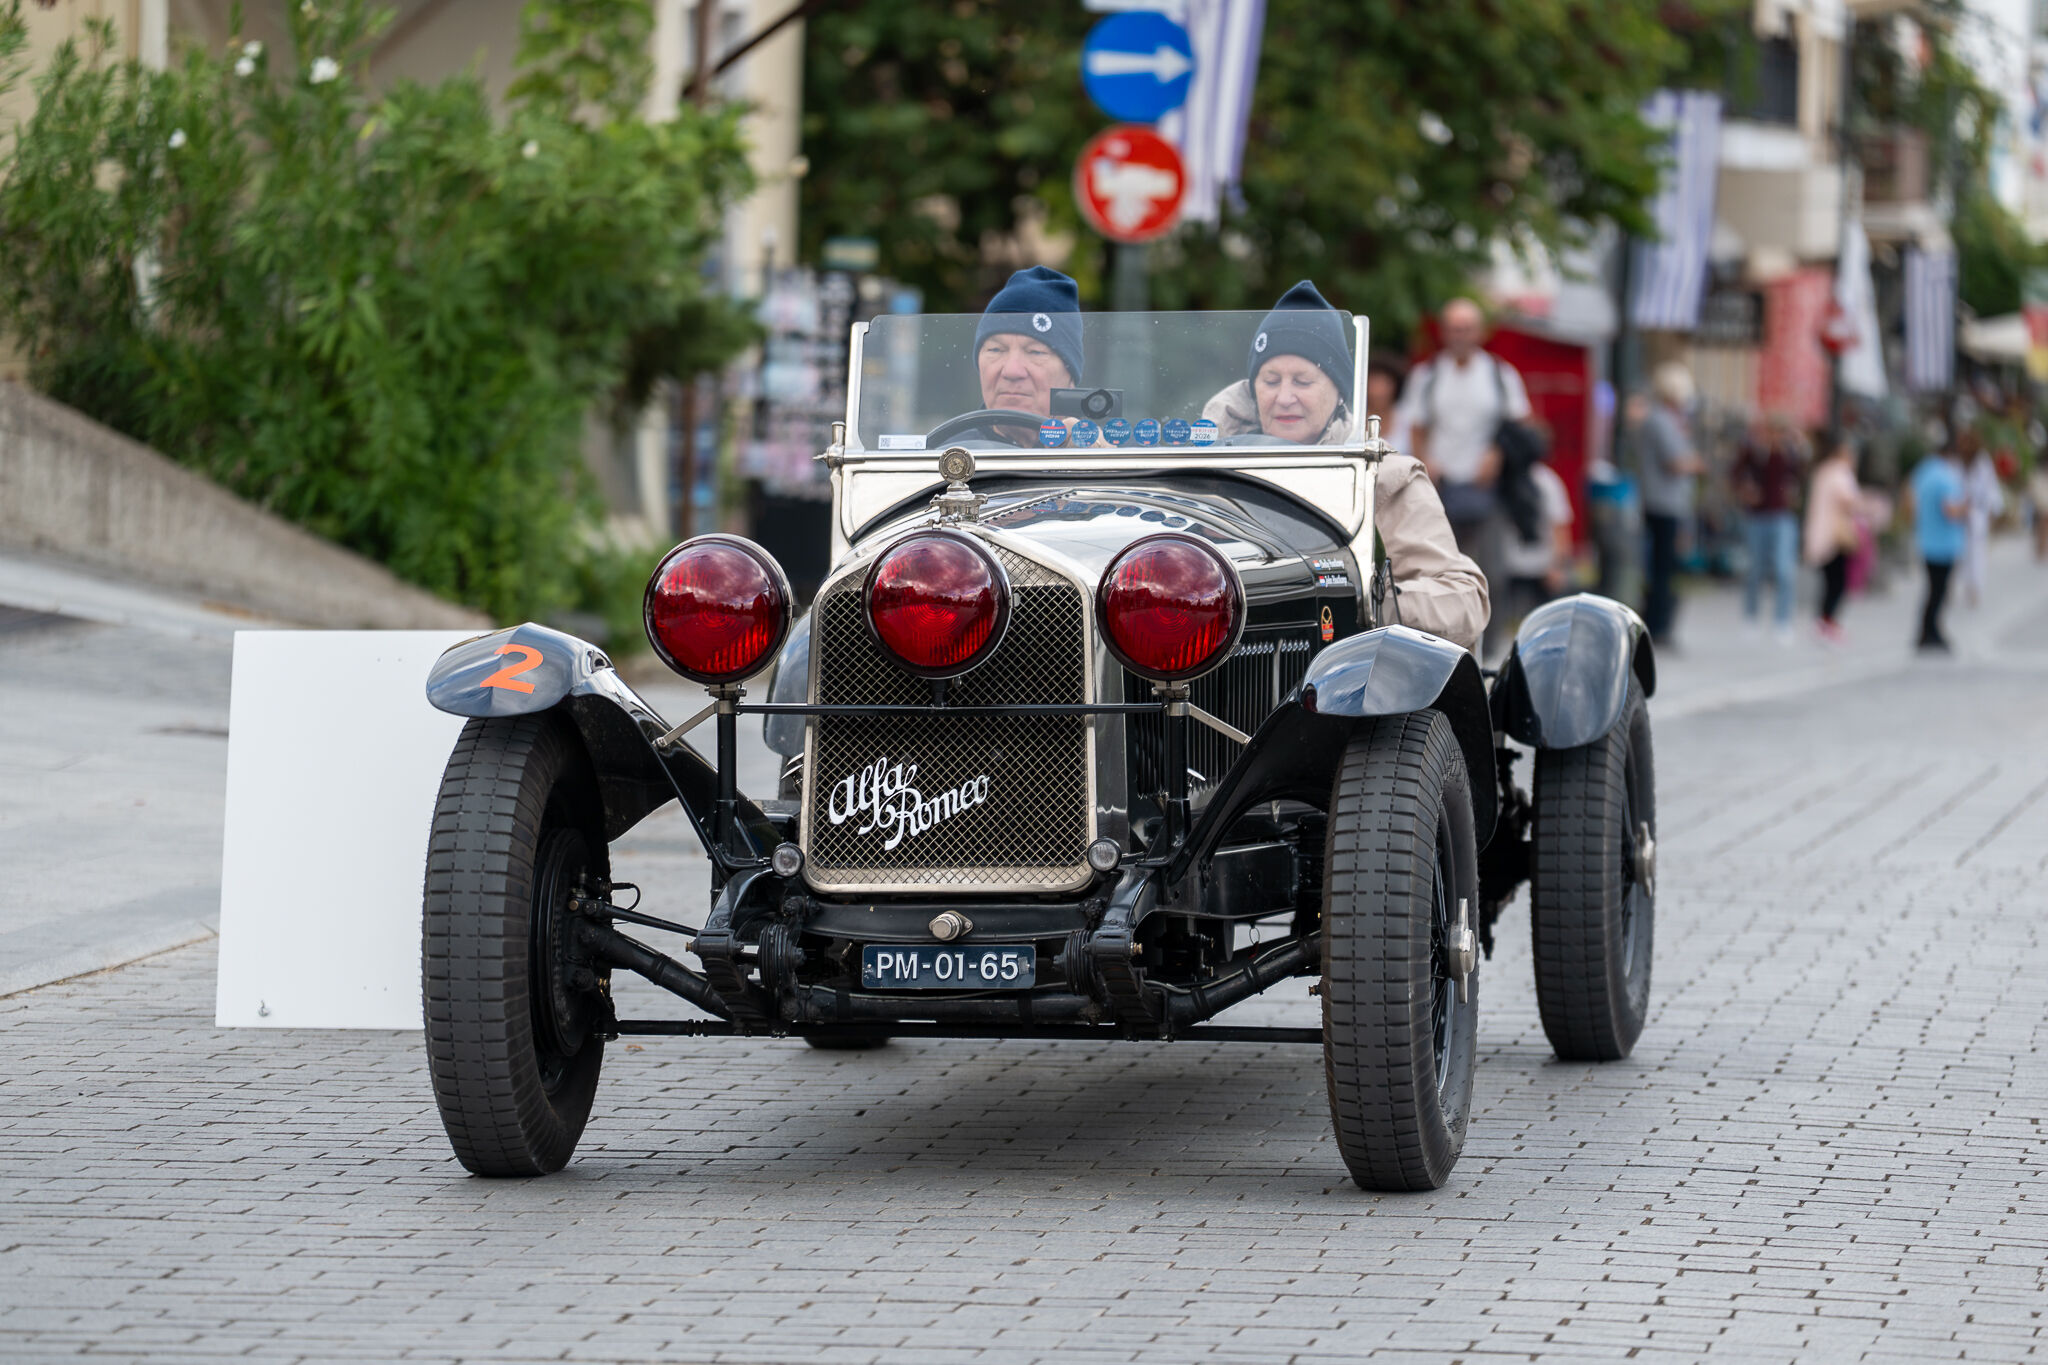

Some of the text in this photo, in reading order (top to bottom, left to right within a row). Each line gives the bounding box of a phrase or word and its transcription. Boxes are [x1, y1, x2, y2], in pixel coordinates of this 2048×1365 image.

[480, 643, 544, 694] 2
[875, 774, 990, 850] Romeo
[876, 953, 1019, 980] PM-01-65
